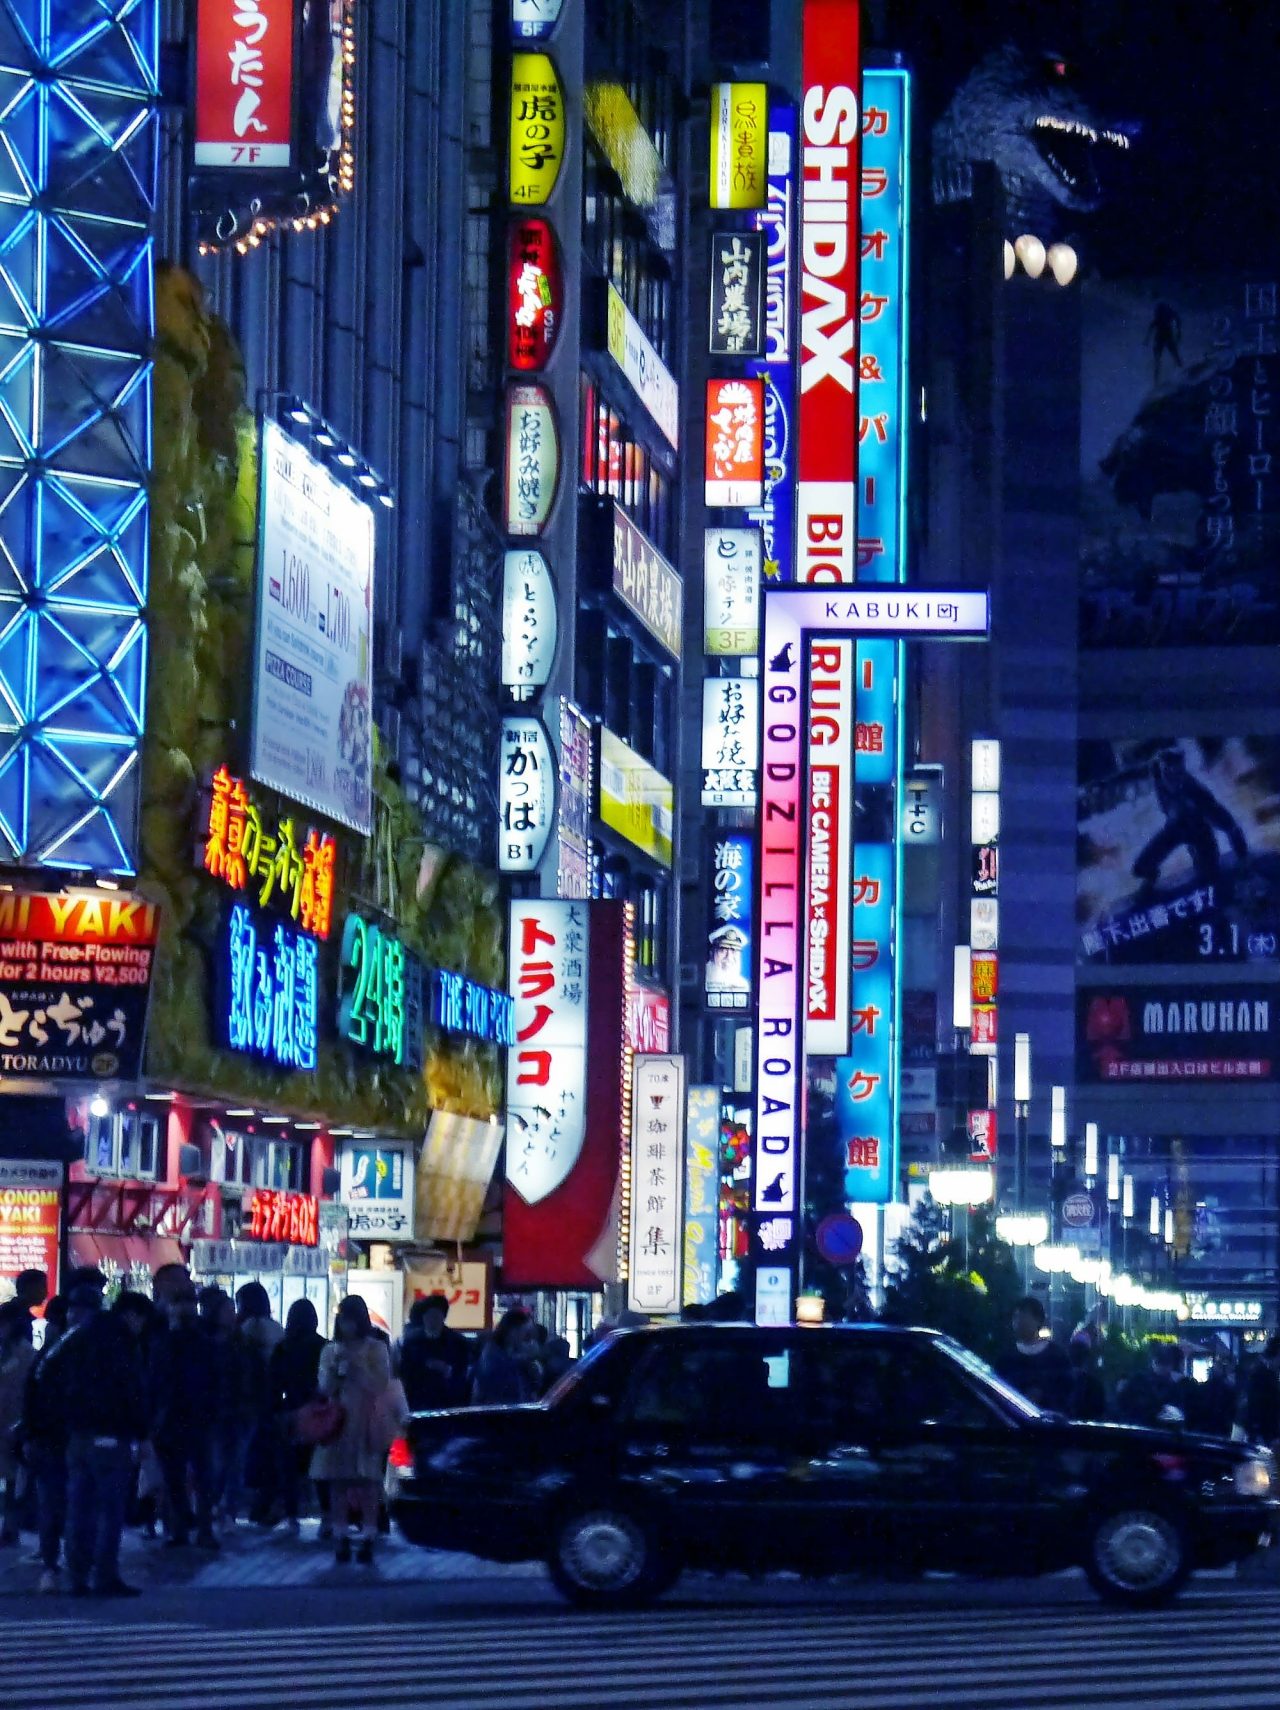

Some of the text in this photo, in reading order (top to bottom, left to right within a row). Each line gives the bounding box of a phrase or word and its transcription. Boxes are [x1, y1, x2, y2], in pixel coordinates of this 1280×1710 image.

[516, 96, 557, 170] 虎の子
[734, 100, 758, 191] 鳥貴族
[230, 147, 262, 163] 7F
[514, 185, 541, 197] 4F
[800, 85, 858, 395] SHIDAX
[719, 632, 747, 649] 3F
[510, 685, 534, 701] 1F
[810, 645, 841, 745] RUG
[505, 731, 538, 744] 新宿
[811, 771, 830, 809] BIC
[507, 844, 533, 860] B1
[714, 841, 743, 920] 海の家
[46, 896, 157, 941] YAKI
[761, 685, 797, 1155] GODZILLA ROAD
[42, 943, 151, 964] Free-Flowing
[561, 906, 582, 1006] 大衆酒場
[26, 962, 38, 979] 2
[41, 962, 91, 981] hours
[95, 965, 148, 985] ¥2,500
[515, 917, 557, 1086] トラノコ
[1143, 1001, 1270, 1033] MARUHAN
[848, 876, 880, 1168] カラオケ館
[3, 1053, 88, 1071] TORADYU
[646, 1119, 667, 1214] 珈琲茶館
[0, 1206, 41, 1223] YAKI
[643, 1224, 671, 1257] 集
